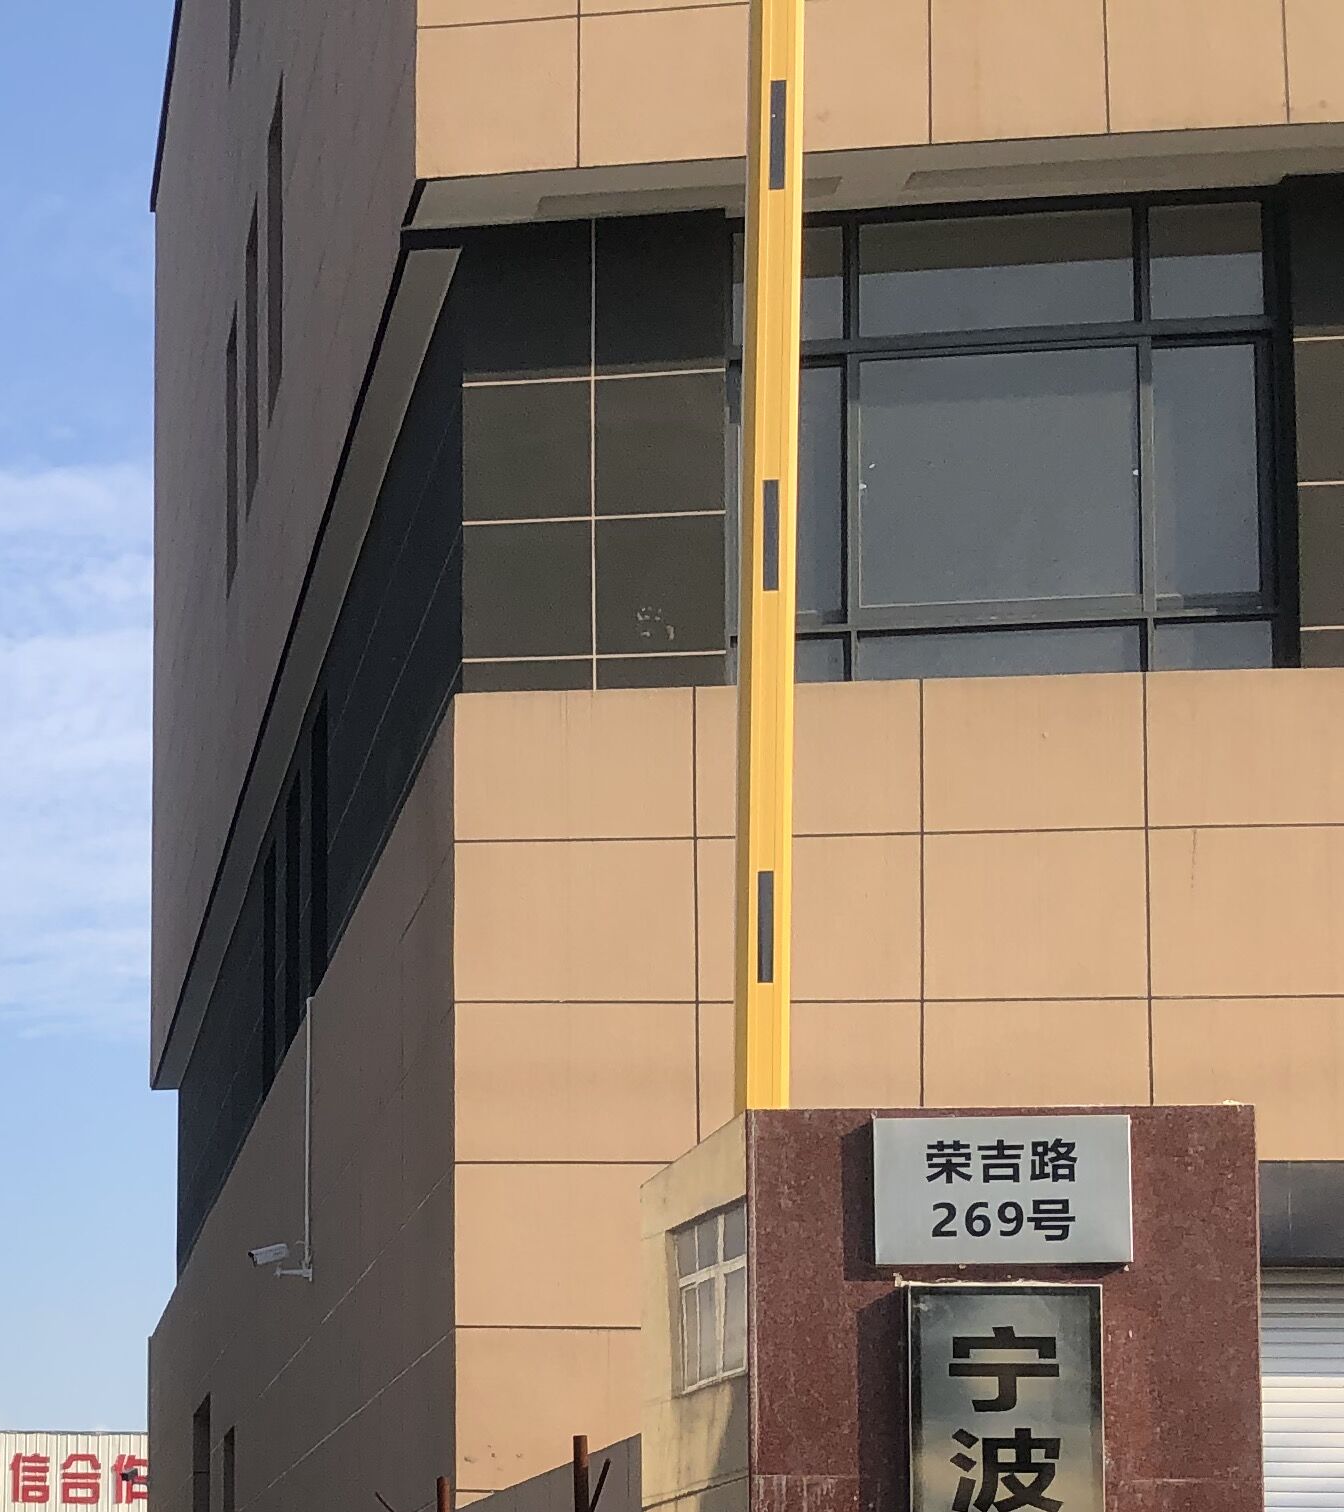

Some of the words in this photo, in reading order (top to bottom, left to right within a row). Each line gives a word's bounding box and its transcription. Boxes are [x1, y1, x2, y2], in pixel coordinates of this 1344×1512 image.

[925, 1137, 1078, 1184] 荣吉路
[931, 1198, 1076, 1242] 269号
